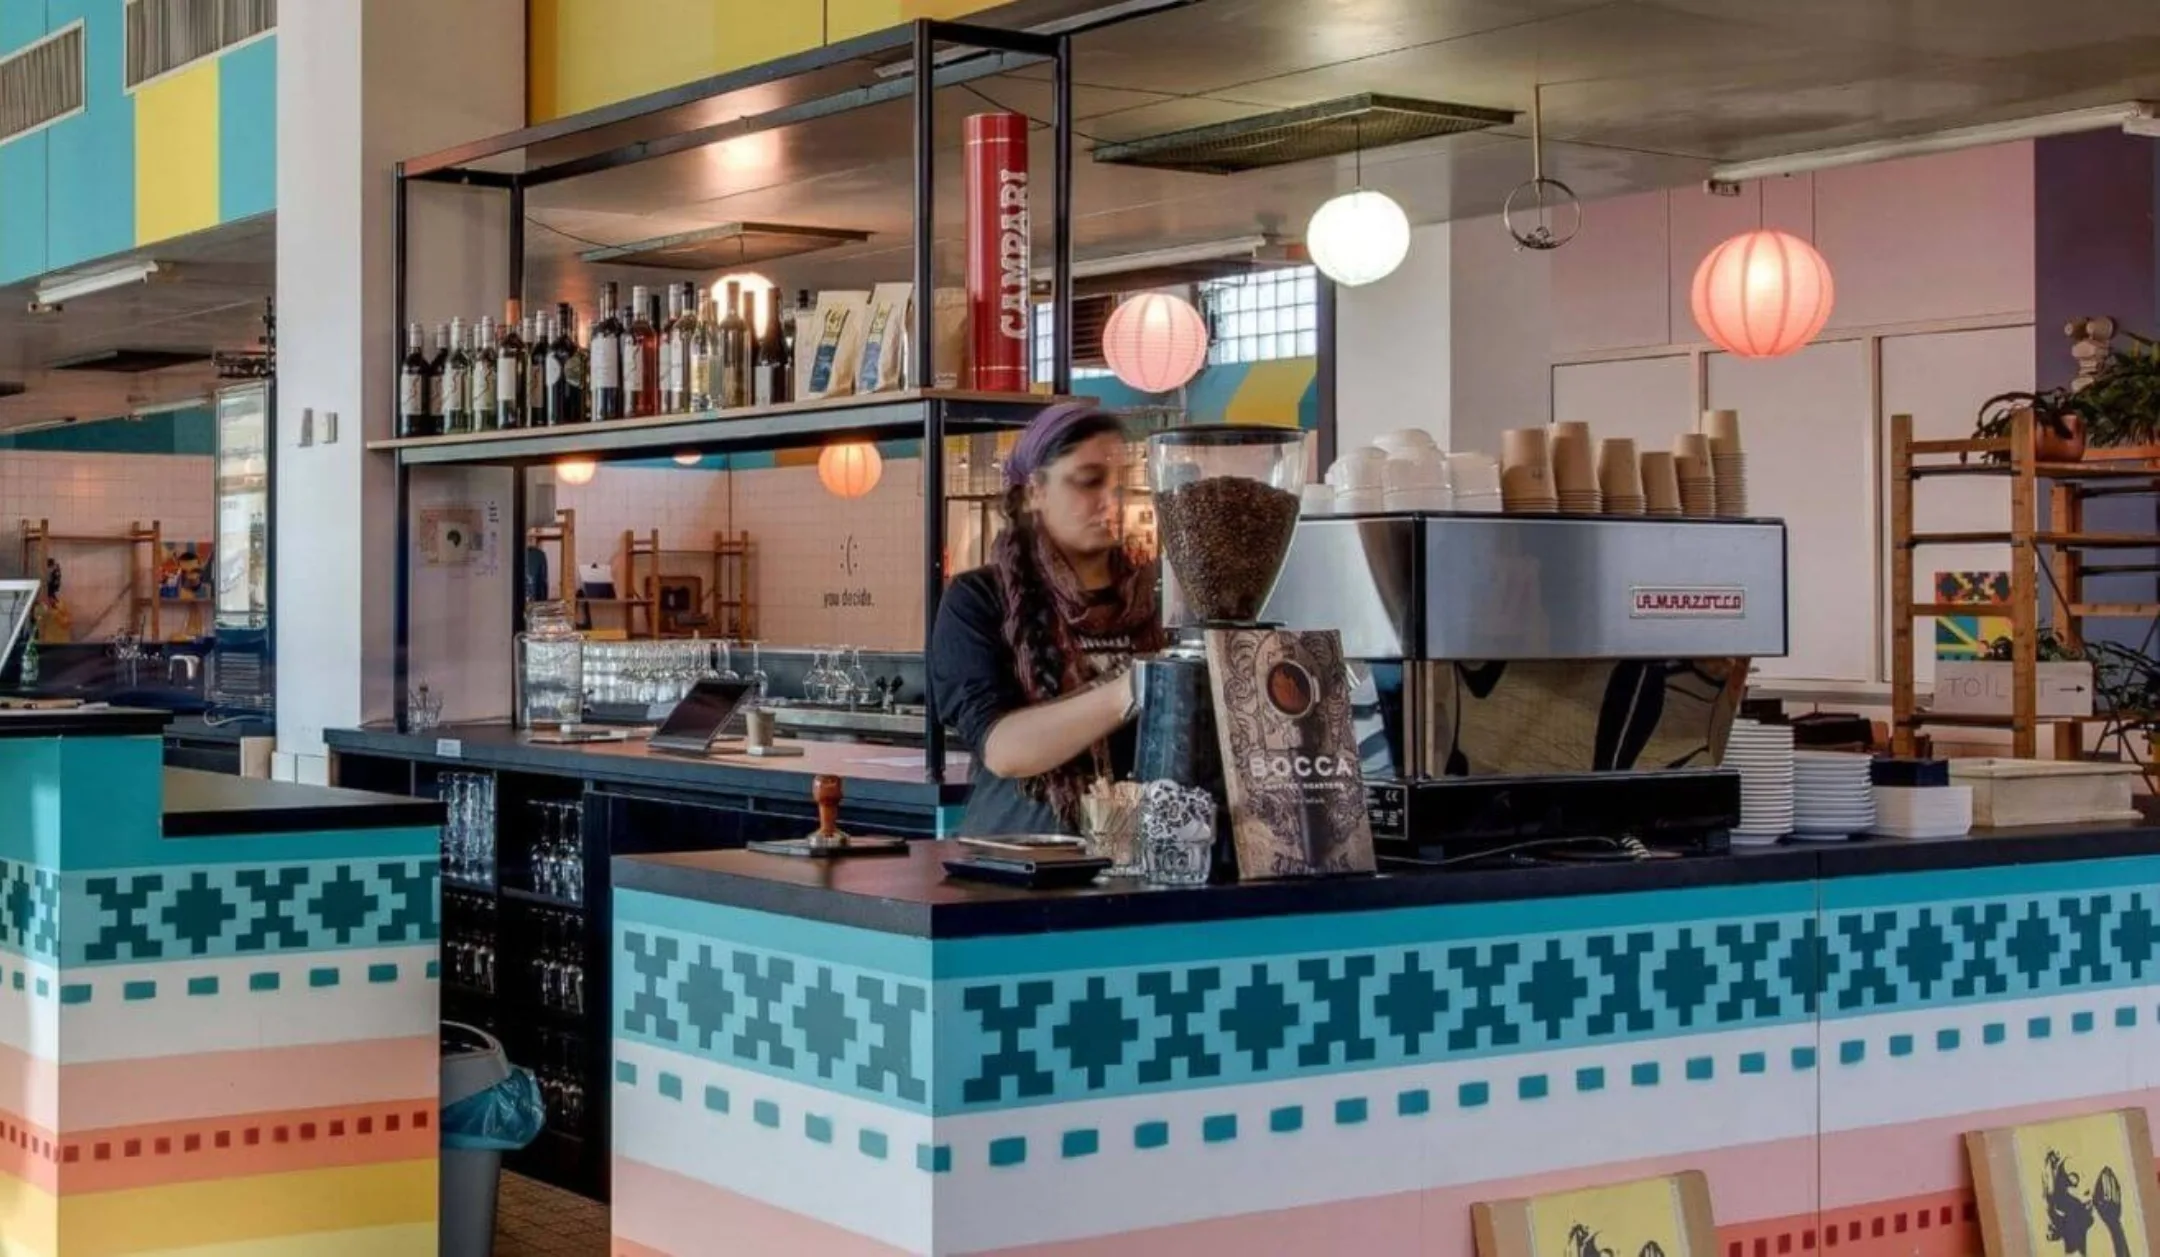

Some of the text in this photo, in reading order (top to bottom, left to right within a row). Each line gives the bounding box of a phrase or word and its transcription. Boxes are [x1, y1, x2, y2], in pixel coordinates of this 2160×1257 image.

[1000, 169, 1029, 340] CAMPARI
[1944, 673, 2054, 699] TOILT
[1249, 755, 1353, 777] BOCCA
